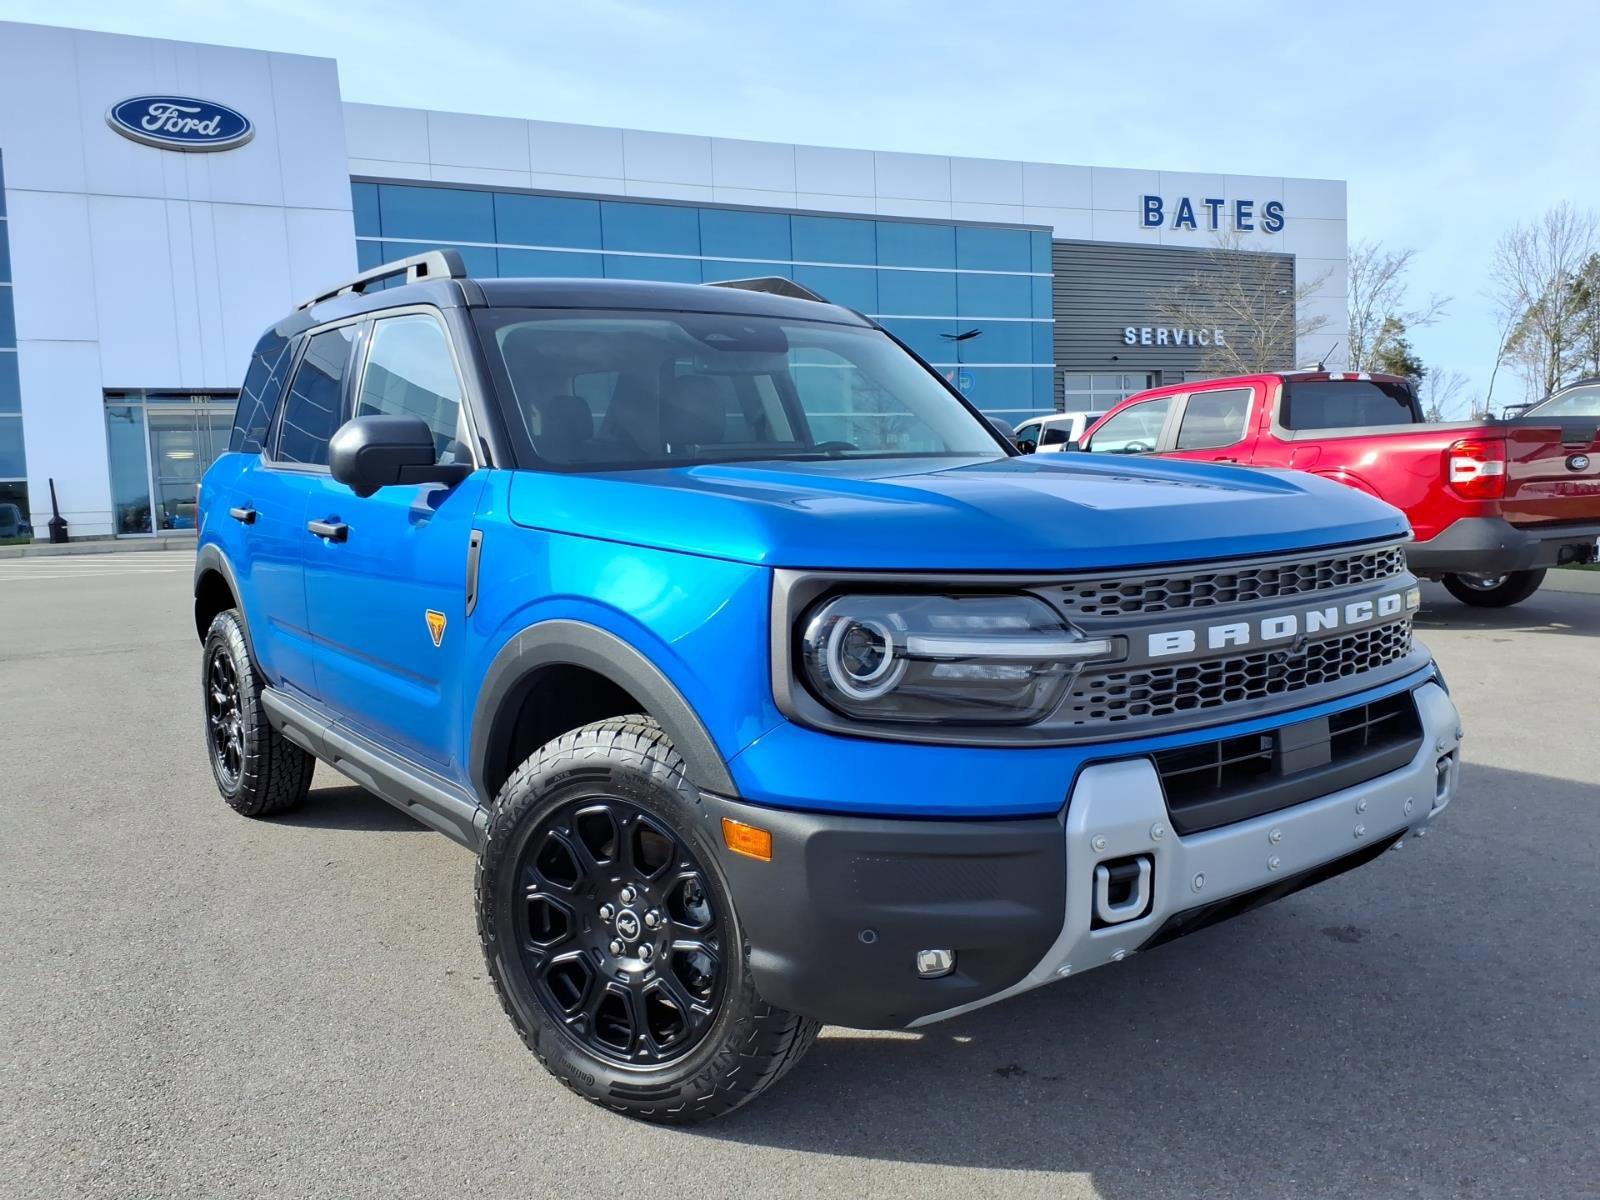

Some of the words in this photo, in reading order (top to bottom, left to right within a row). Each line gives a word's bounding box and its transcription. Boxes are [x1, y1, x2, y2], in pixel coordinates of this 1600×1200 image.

[141, 102, 221, 135] Ford
[1143, 195, 1285, 233] BATES
[1124, 326, 1225, 346] SERVICE
[1148, 593, 1401, 657] BRONCO
